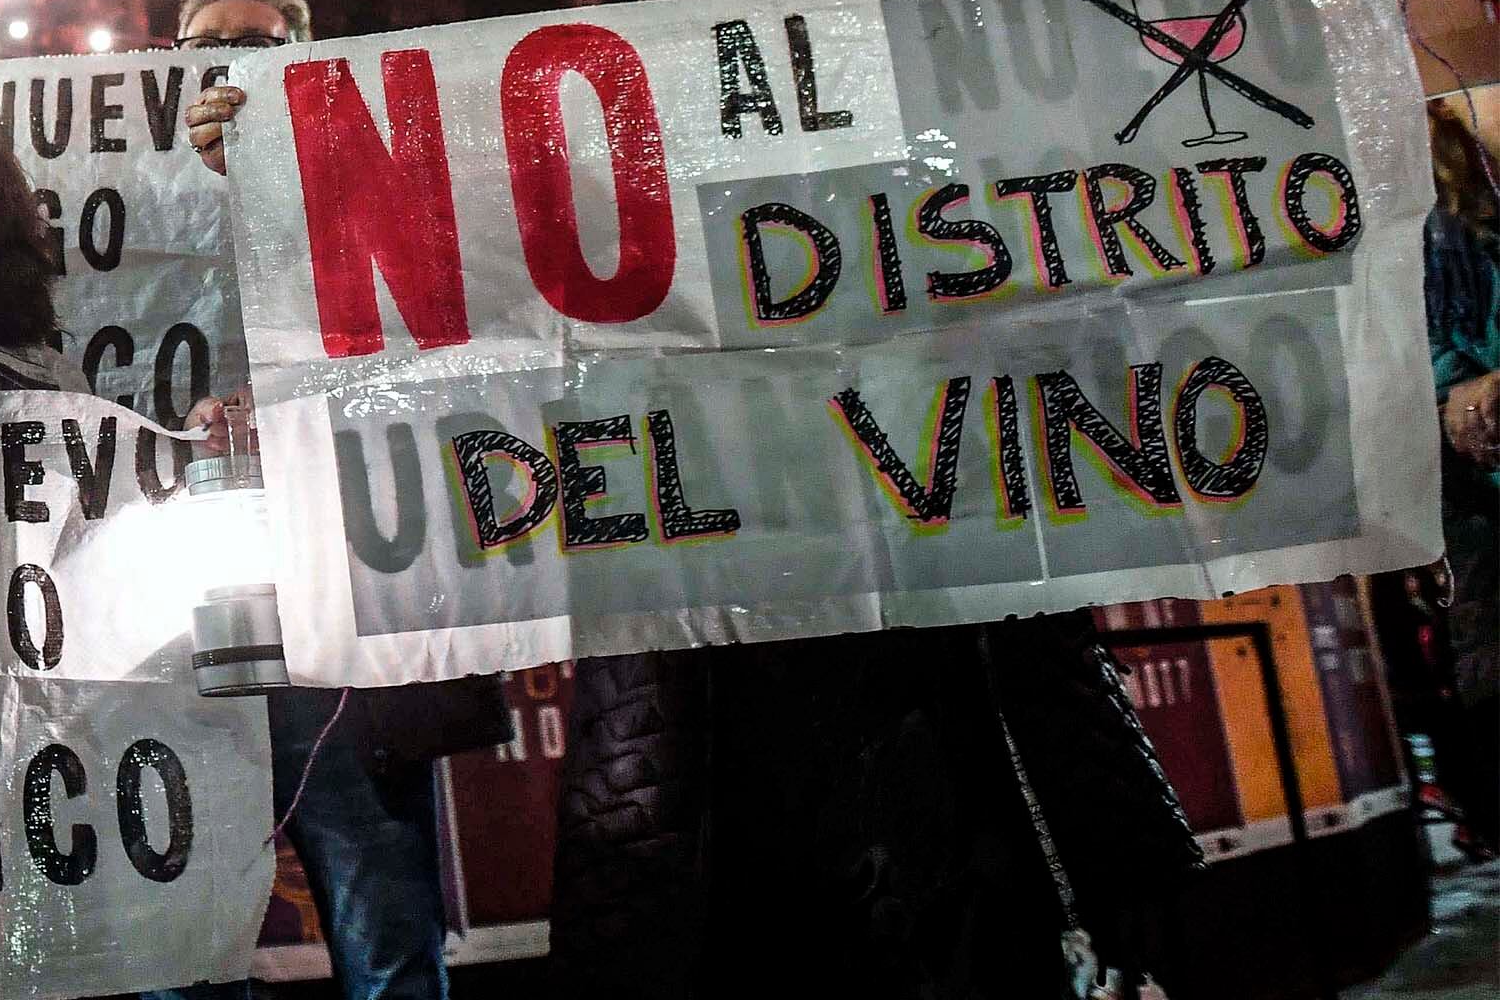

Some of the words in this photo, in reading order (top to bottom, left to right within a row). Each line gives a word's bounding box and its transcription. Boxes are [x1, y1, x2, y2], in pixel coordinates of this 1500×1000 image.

[283, 23, 676, 357] NO
[713, 12, 855, 139] AL
[741, 151, 1363, 325] DISTRITO
[444, 409, 742, 557] DEL
[827, 355, 1269, 530] VINO
